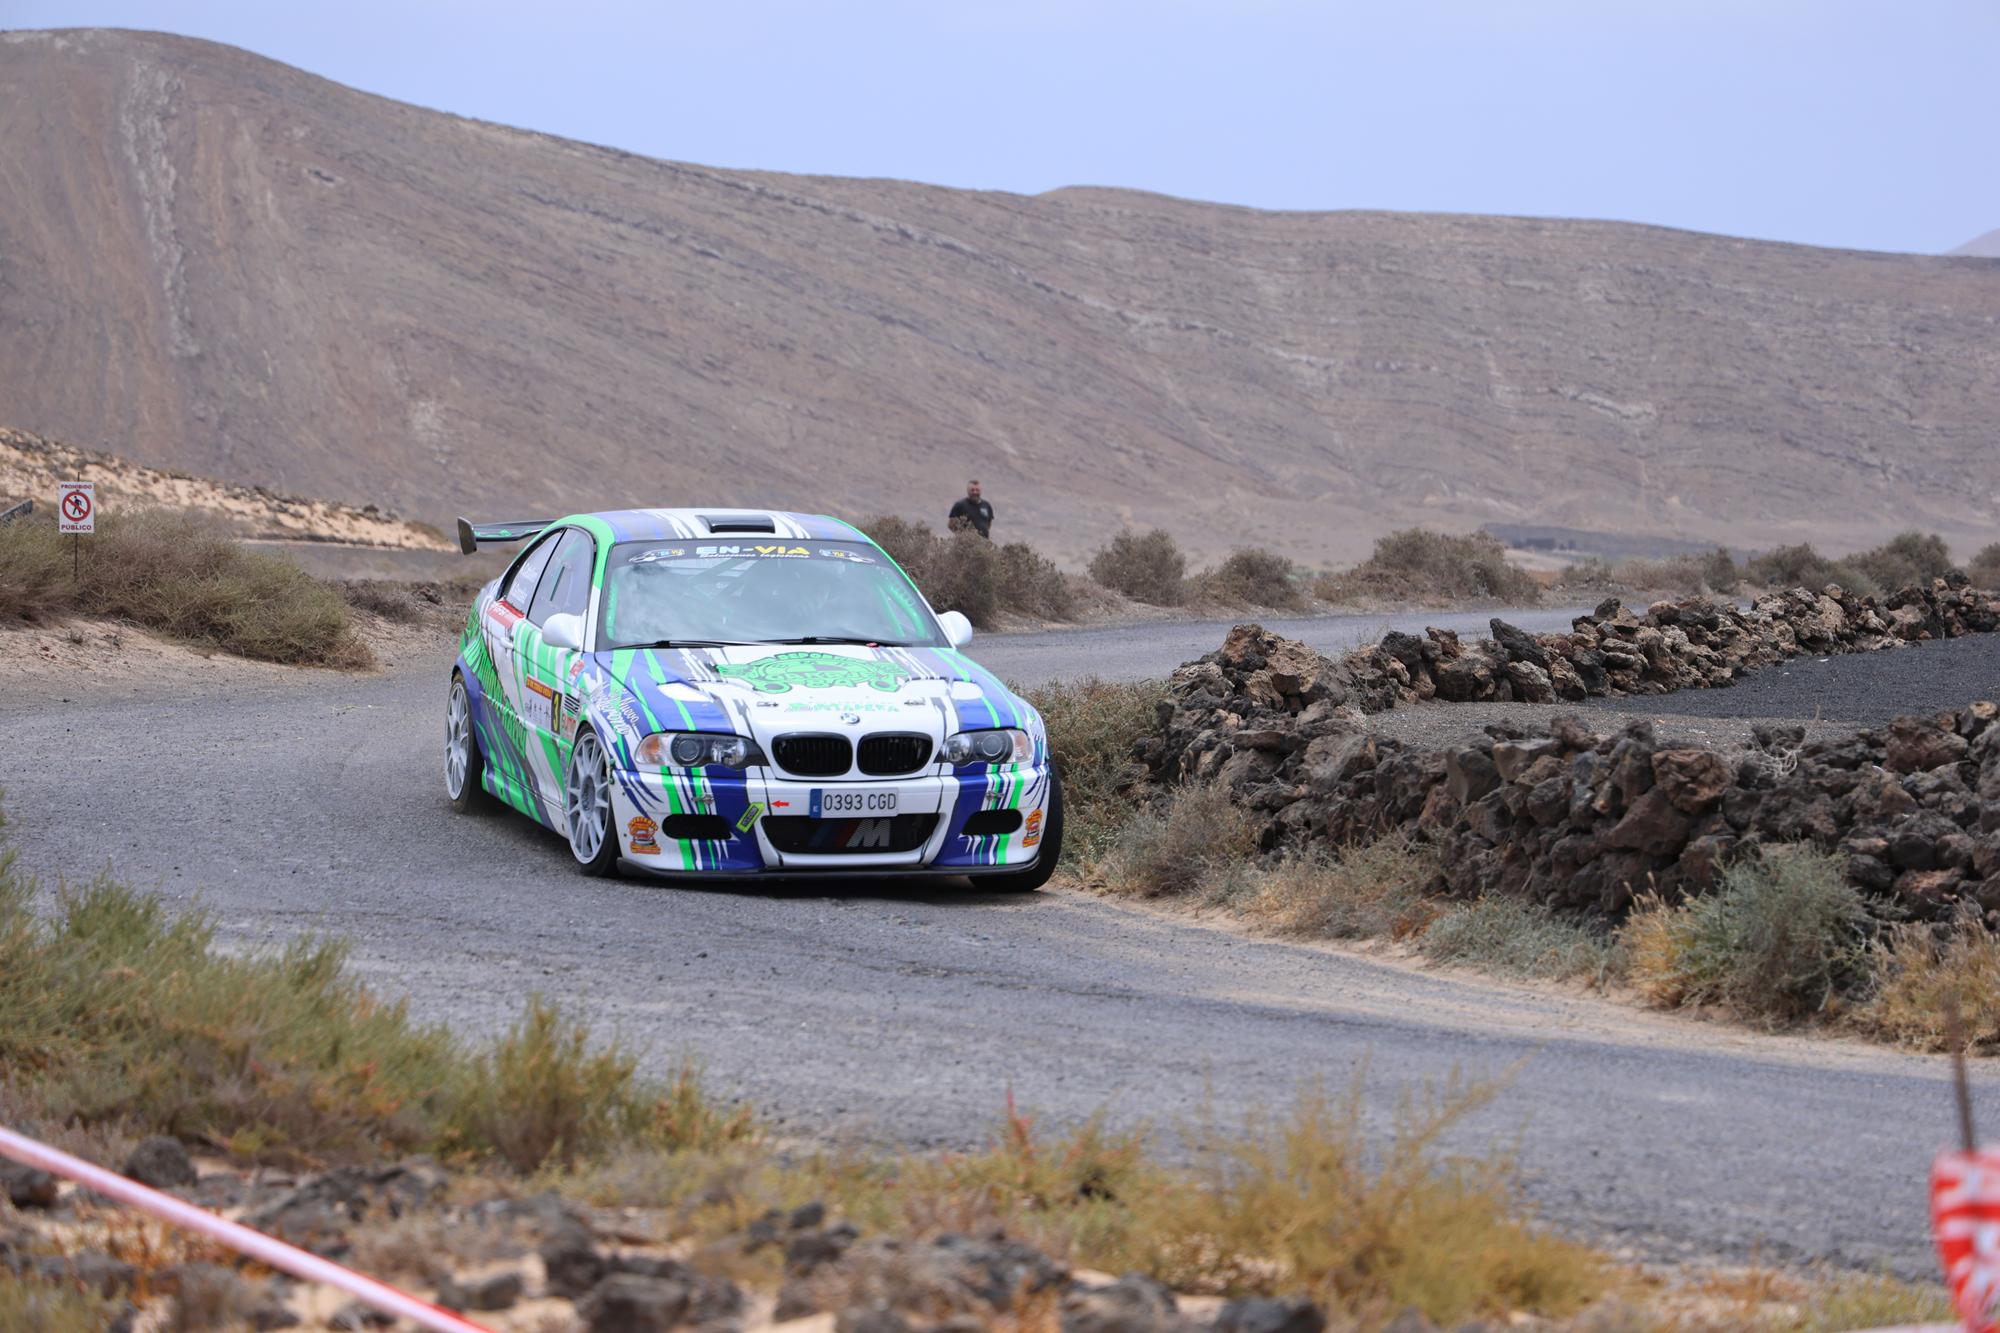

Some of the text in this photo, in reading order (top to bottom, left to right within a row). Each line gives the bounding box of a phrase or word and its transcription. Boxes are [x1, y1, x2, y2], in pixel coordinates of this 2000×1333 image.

[696, 546, 810, 554] EN-VIA
[552, 693, 560, 732] 3
[823, 793, 897, 811] 0393 CGD
